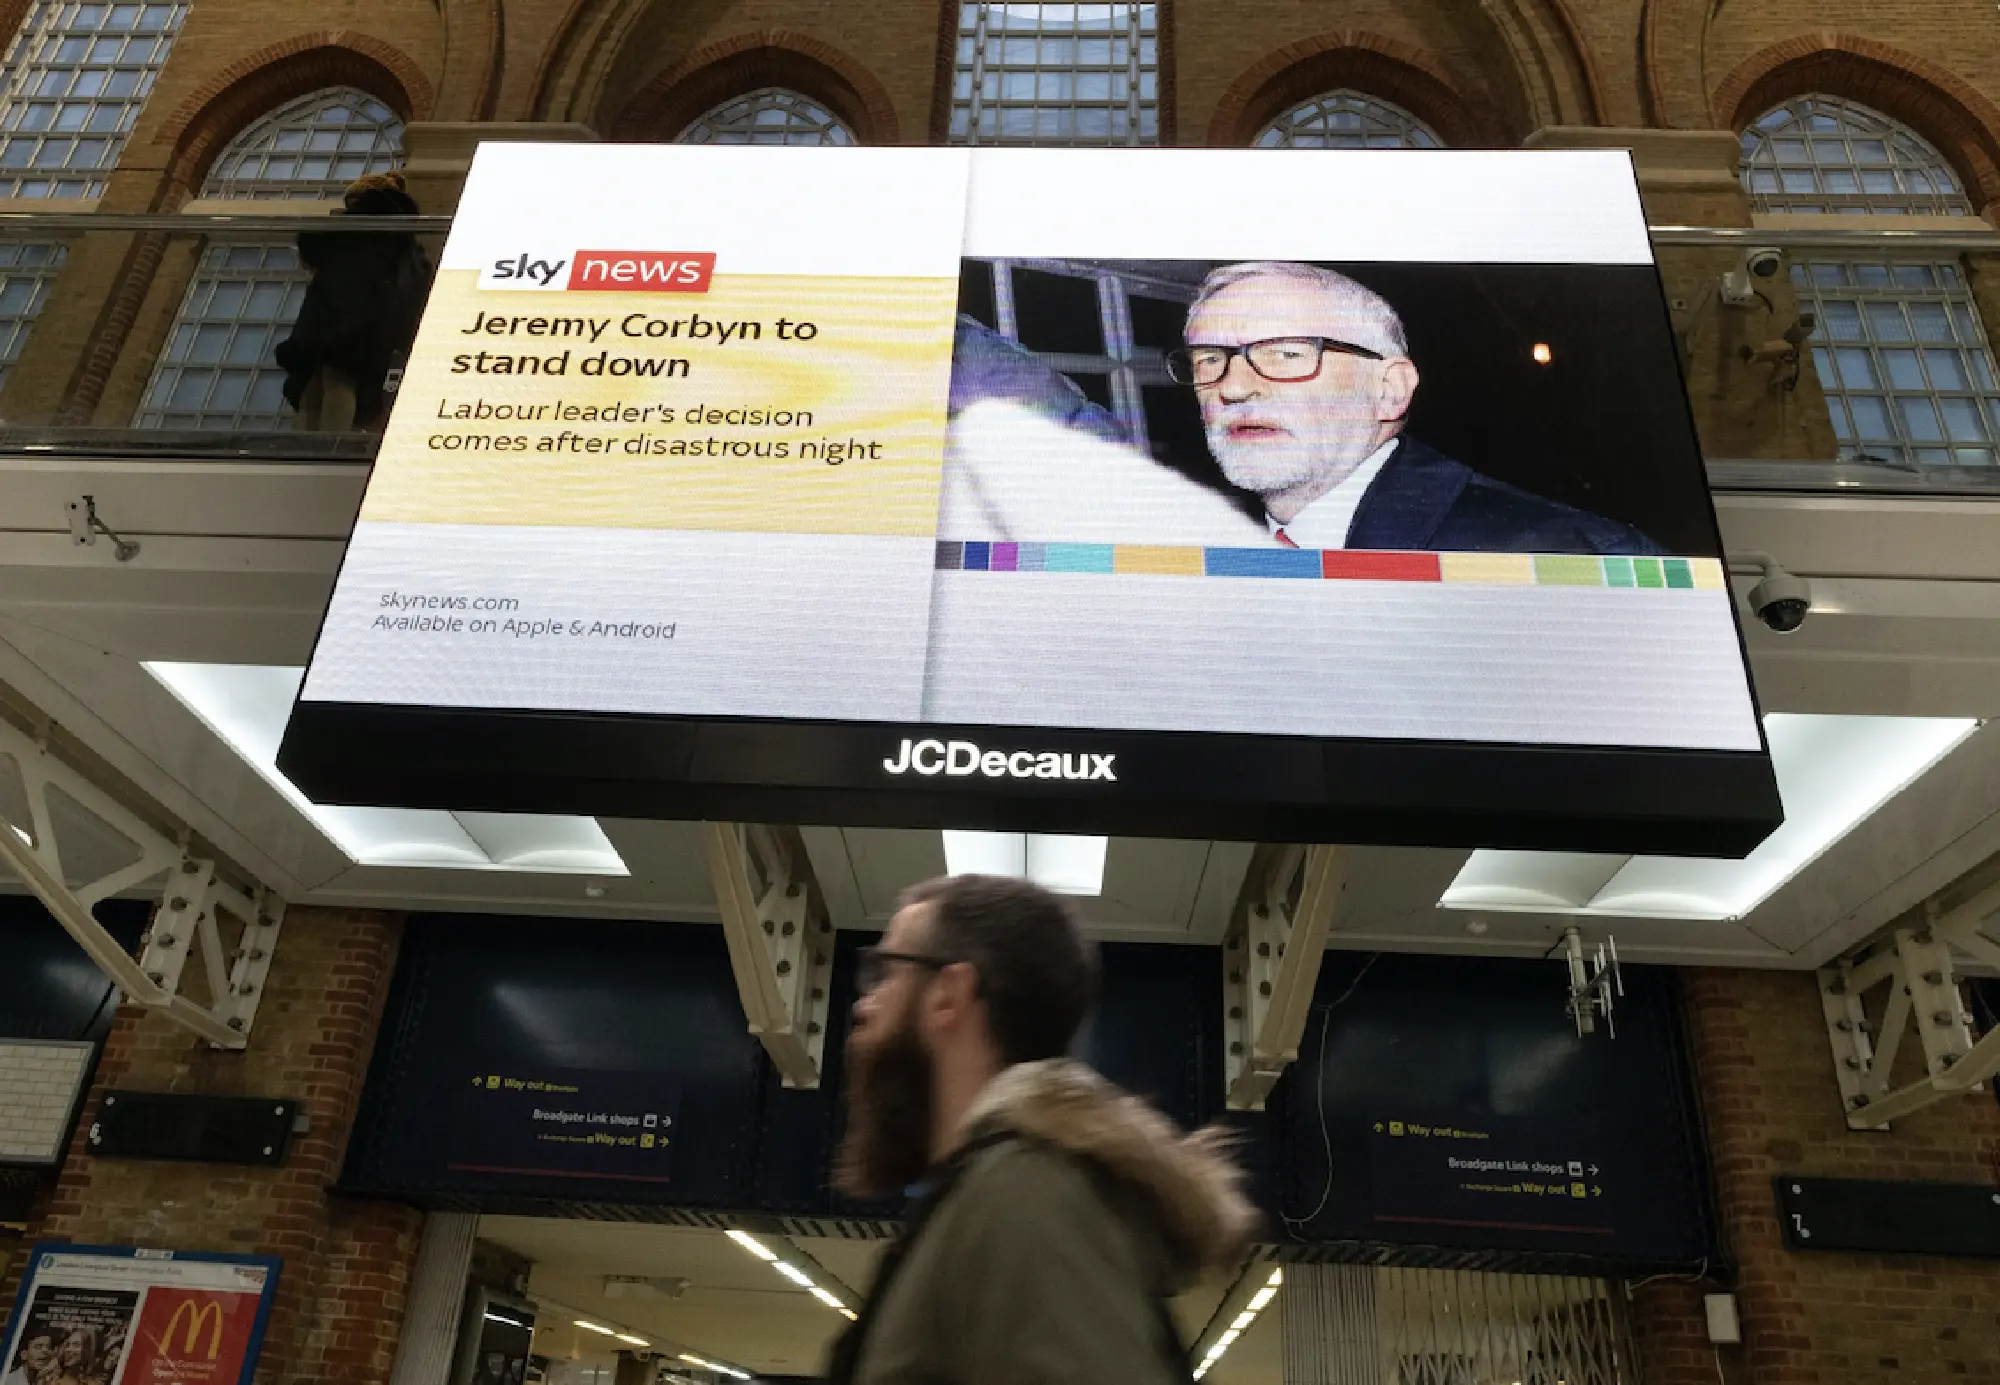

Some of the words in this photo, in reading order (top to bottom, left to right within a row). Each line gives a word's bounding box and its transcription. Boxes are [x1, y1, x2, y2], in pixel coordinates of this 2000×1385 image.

[492, 253, 566, 286] sky
[582, 259, 701, 283] news
[461, 311, 611, 343] Jeremy
[620, 314, 762, 344] Corbyn
[775, 317, 819, 340] to
[450, 350, 571, 376] stand
[580, 350, 690, 377] down
[436, 398, 549, 420] Labour
[554, 400, 675, 423] leader's
[685, 404, 813, 426] decision
[427, 431, 528, 451] comes
[536, 430, 618, 454] after
[624, 433, 789, 458] disastrous
[799, 437, 882, 465] night
[379, 592, 519, 611] skynews.com
[372, 615, 464, 633] Available
[469, 619, 497, 633] on
[502, 618, 563, 638] Apple
[569, 620, 584, 636] &
[588, 621, 676, 639] Android
[882, 738, 1118, 782] JCDecaux
[533, 1108, 584, 1124] Broadgate
[587, 1111, 607, 1124] Link
[610, 1113, 639, 1127] shops
[1408, 1124, 1431, 1138] Way
[1449, 1156, 1504, 1171] Broadgate
[1506, 1160, 1529, 1171] Link
[1532, 1163, 1564, 1175] shops
[1521, 1182, 1544, 1196] Way
